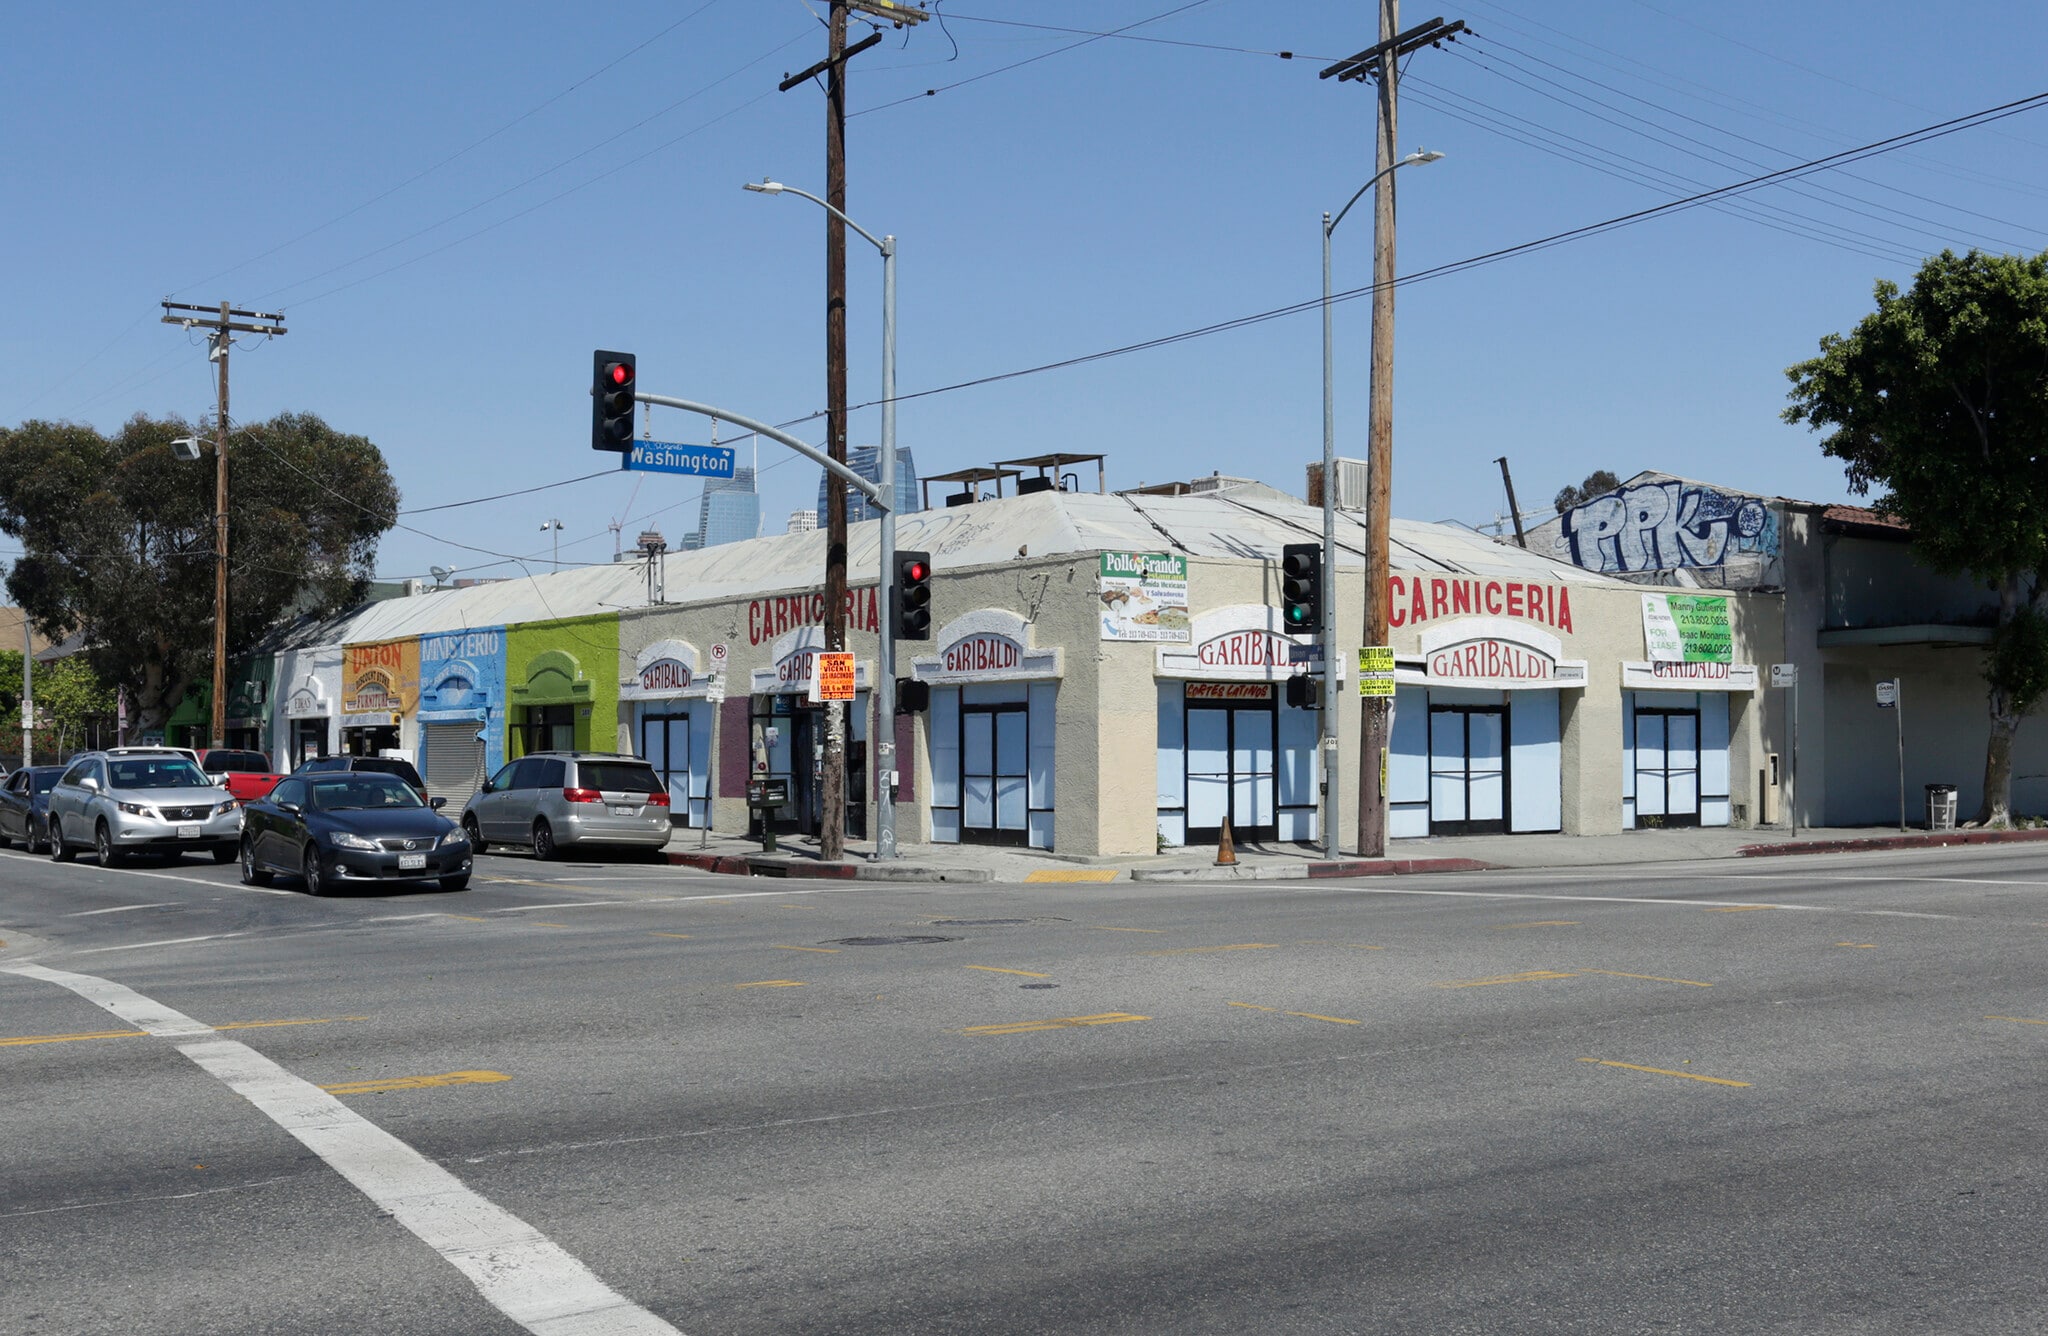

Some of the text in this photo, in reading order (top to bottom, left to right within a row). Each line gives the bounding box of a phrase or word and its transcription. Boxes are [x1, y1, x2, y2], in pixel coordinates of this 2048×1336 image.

[631, 448, 729, 474] Washington
[1106, 553, 1182, 574] Pollo Grande
[749, 586, 879, 646] CARNICRIA
[1387, 576, 1573, 635] CARNICERIA
[1670, 602, 1694, 612] Manny
[422, 630, 499, 661] MINISTERIO
[1650, 629, 1667, 637] FOR
[1651, 641, 1677, 650] LEASE
[1680, 630, 1698, 639] Isaac
[353, 643, 403, 674] UNION
[947, 639, 1017, 671] GARIBALDI
[1200, 631, 1305, 667] GARIBAL
[1433, 640, 1548, 679] GARIBALDI
[643, 663, 691, 690] GARIBALDI
[780, 652, 813, 681] GARIB
